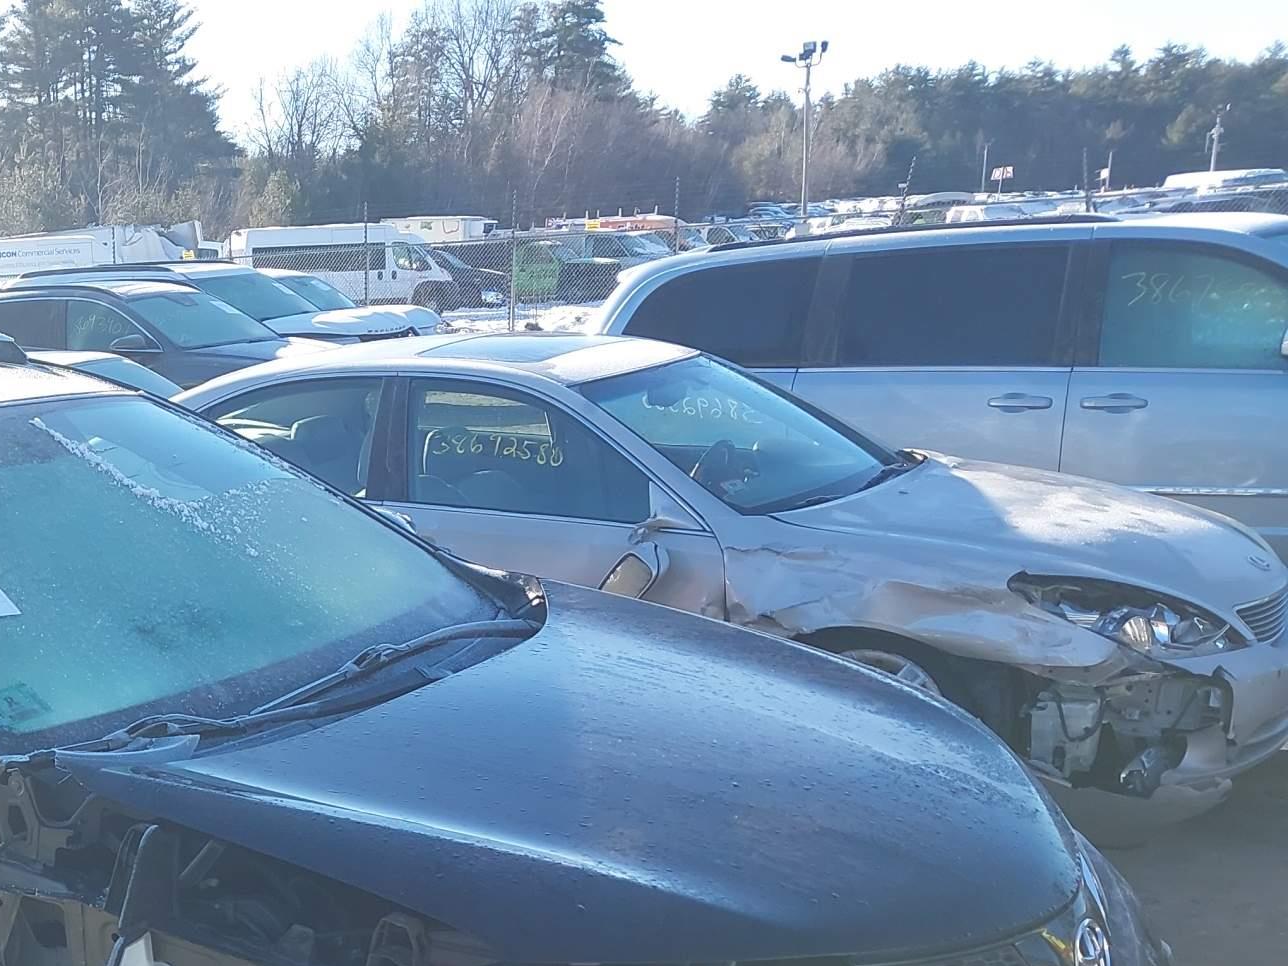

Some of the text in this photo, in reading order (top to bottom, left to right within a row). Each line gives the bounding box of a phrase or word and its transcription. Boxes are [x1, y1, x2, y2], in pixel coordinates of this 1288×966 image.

[17, 248, 55, 257] Commercial
[55, 246, 81, 255] Services
[432, 433, 564, 467] 38692580
